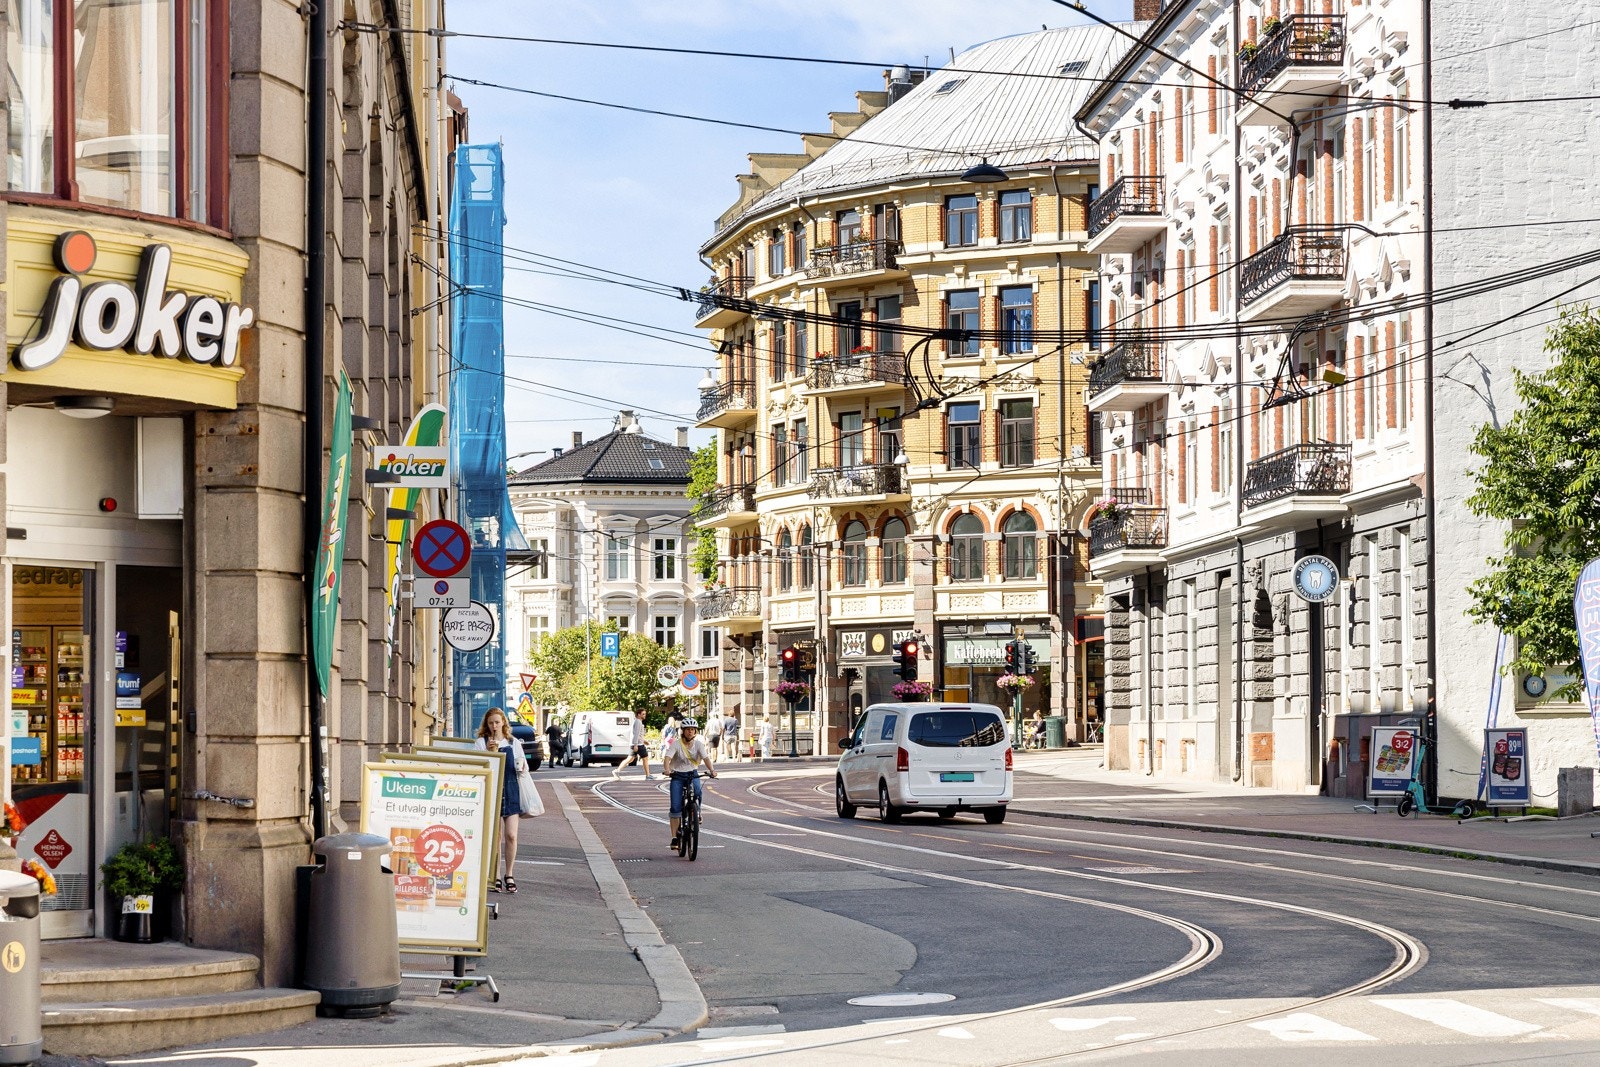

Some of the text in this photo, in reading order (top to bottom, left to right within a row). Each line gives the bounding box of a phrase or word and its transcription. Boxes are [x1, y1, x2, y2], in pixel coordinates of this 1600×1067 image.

[14, 230, 254, 370] joker
[385, 453, 442, 475] joker
[1298, 558, 1335, 573] DENTAL PARK
[428, 597, 455, 606] 07-12
[444, 620, 492, 633] ARTE PAZZA
[605, 636, 615, 650] P
[953, 644, 1007, 660] Kaffebrenn
[116, 677, 141, 689] trumf
[12, 692, 33, 700] DHL
[386, 780, 476, 798] Ukens joker
[385, 801, 396, 812] Et
[398, 803, 427, 816] utvalg
[429, 805, 475, 817] grillpølser
[423, 839, 455, 864] 25
[455, 847, 464, 856] kr
[393, 885, 428, 894] RILLPØLSE
